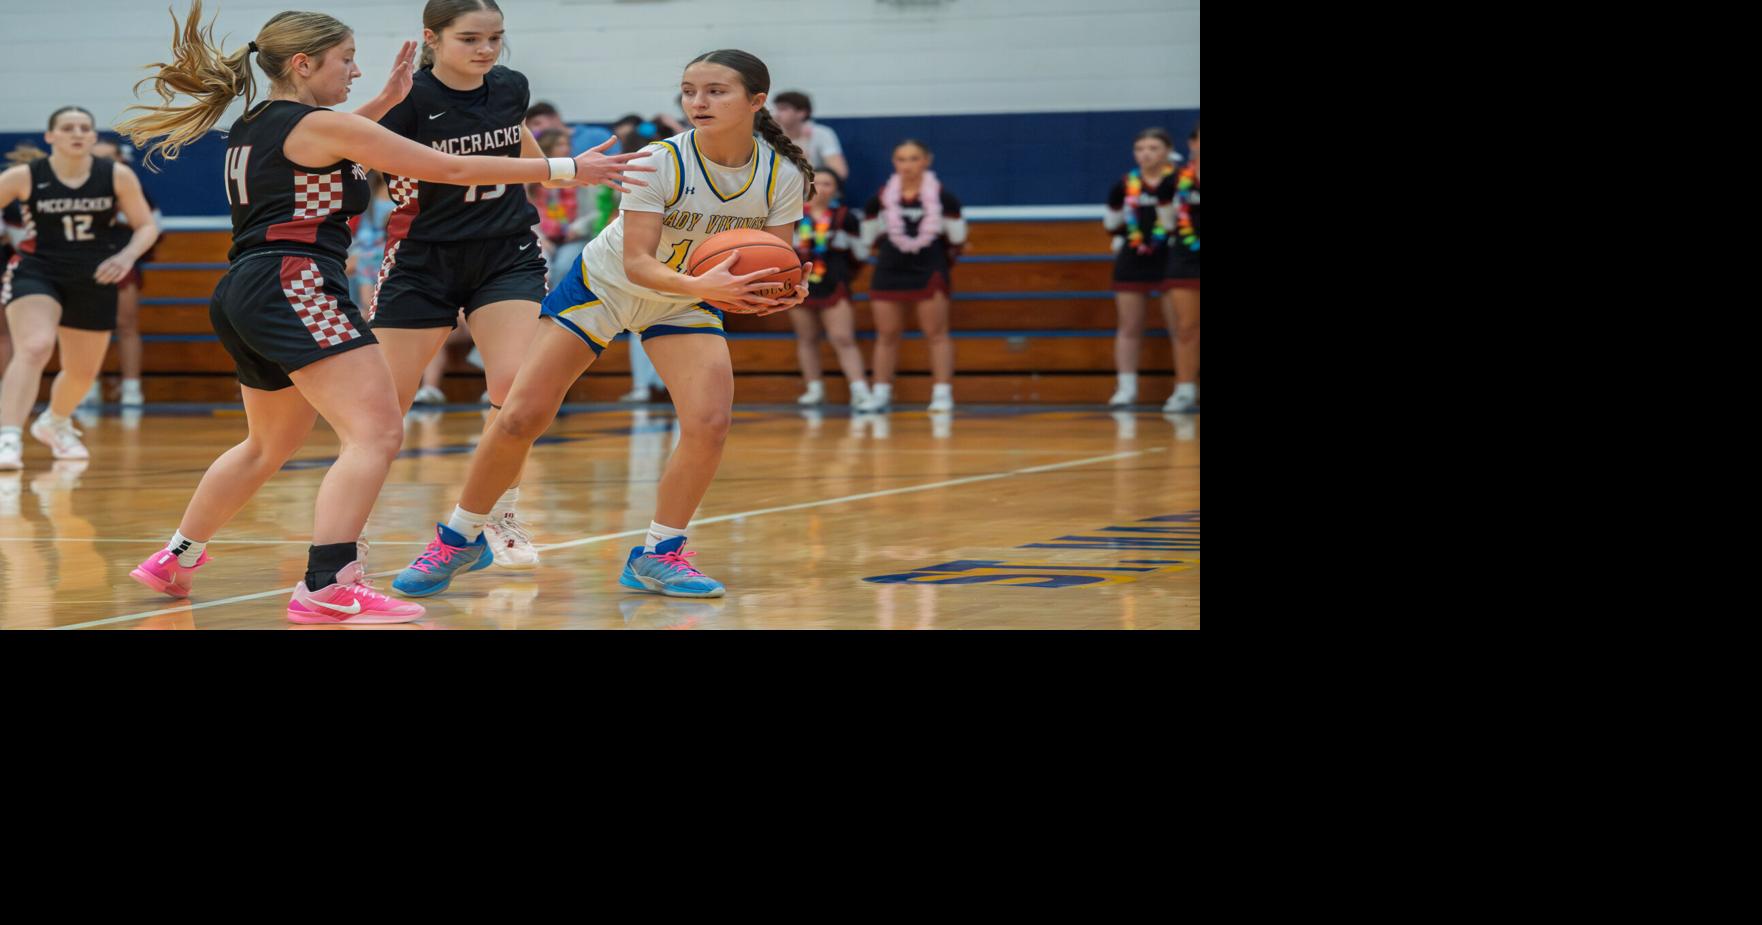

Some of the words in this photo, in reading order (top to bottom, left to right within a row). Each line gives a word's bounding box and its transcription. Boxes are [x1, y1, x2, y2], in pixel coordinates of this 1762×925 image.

[431, 124, 522, 156] MCCRACKE
[224, 144, 253, 206] 14
[61, 214, 96, 242] 12
[662, 209, 704, 232] ADY
